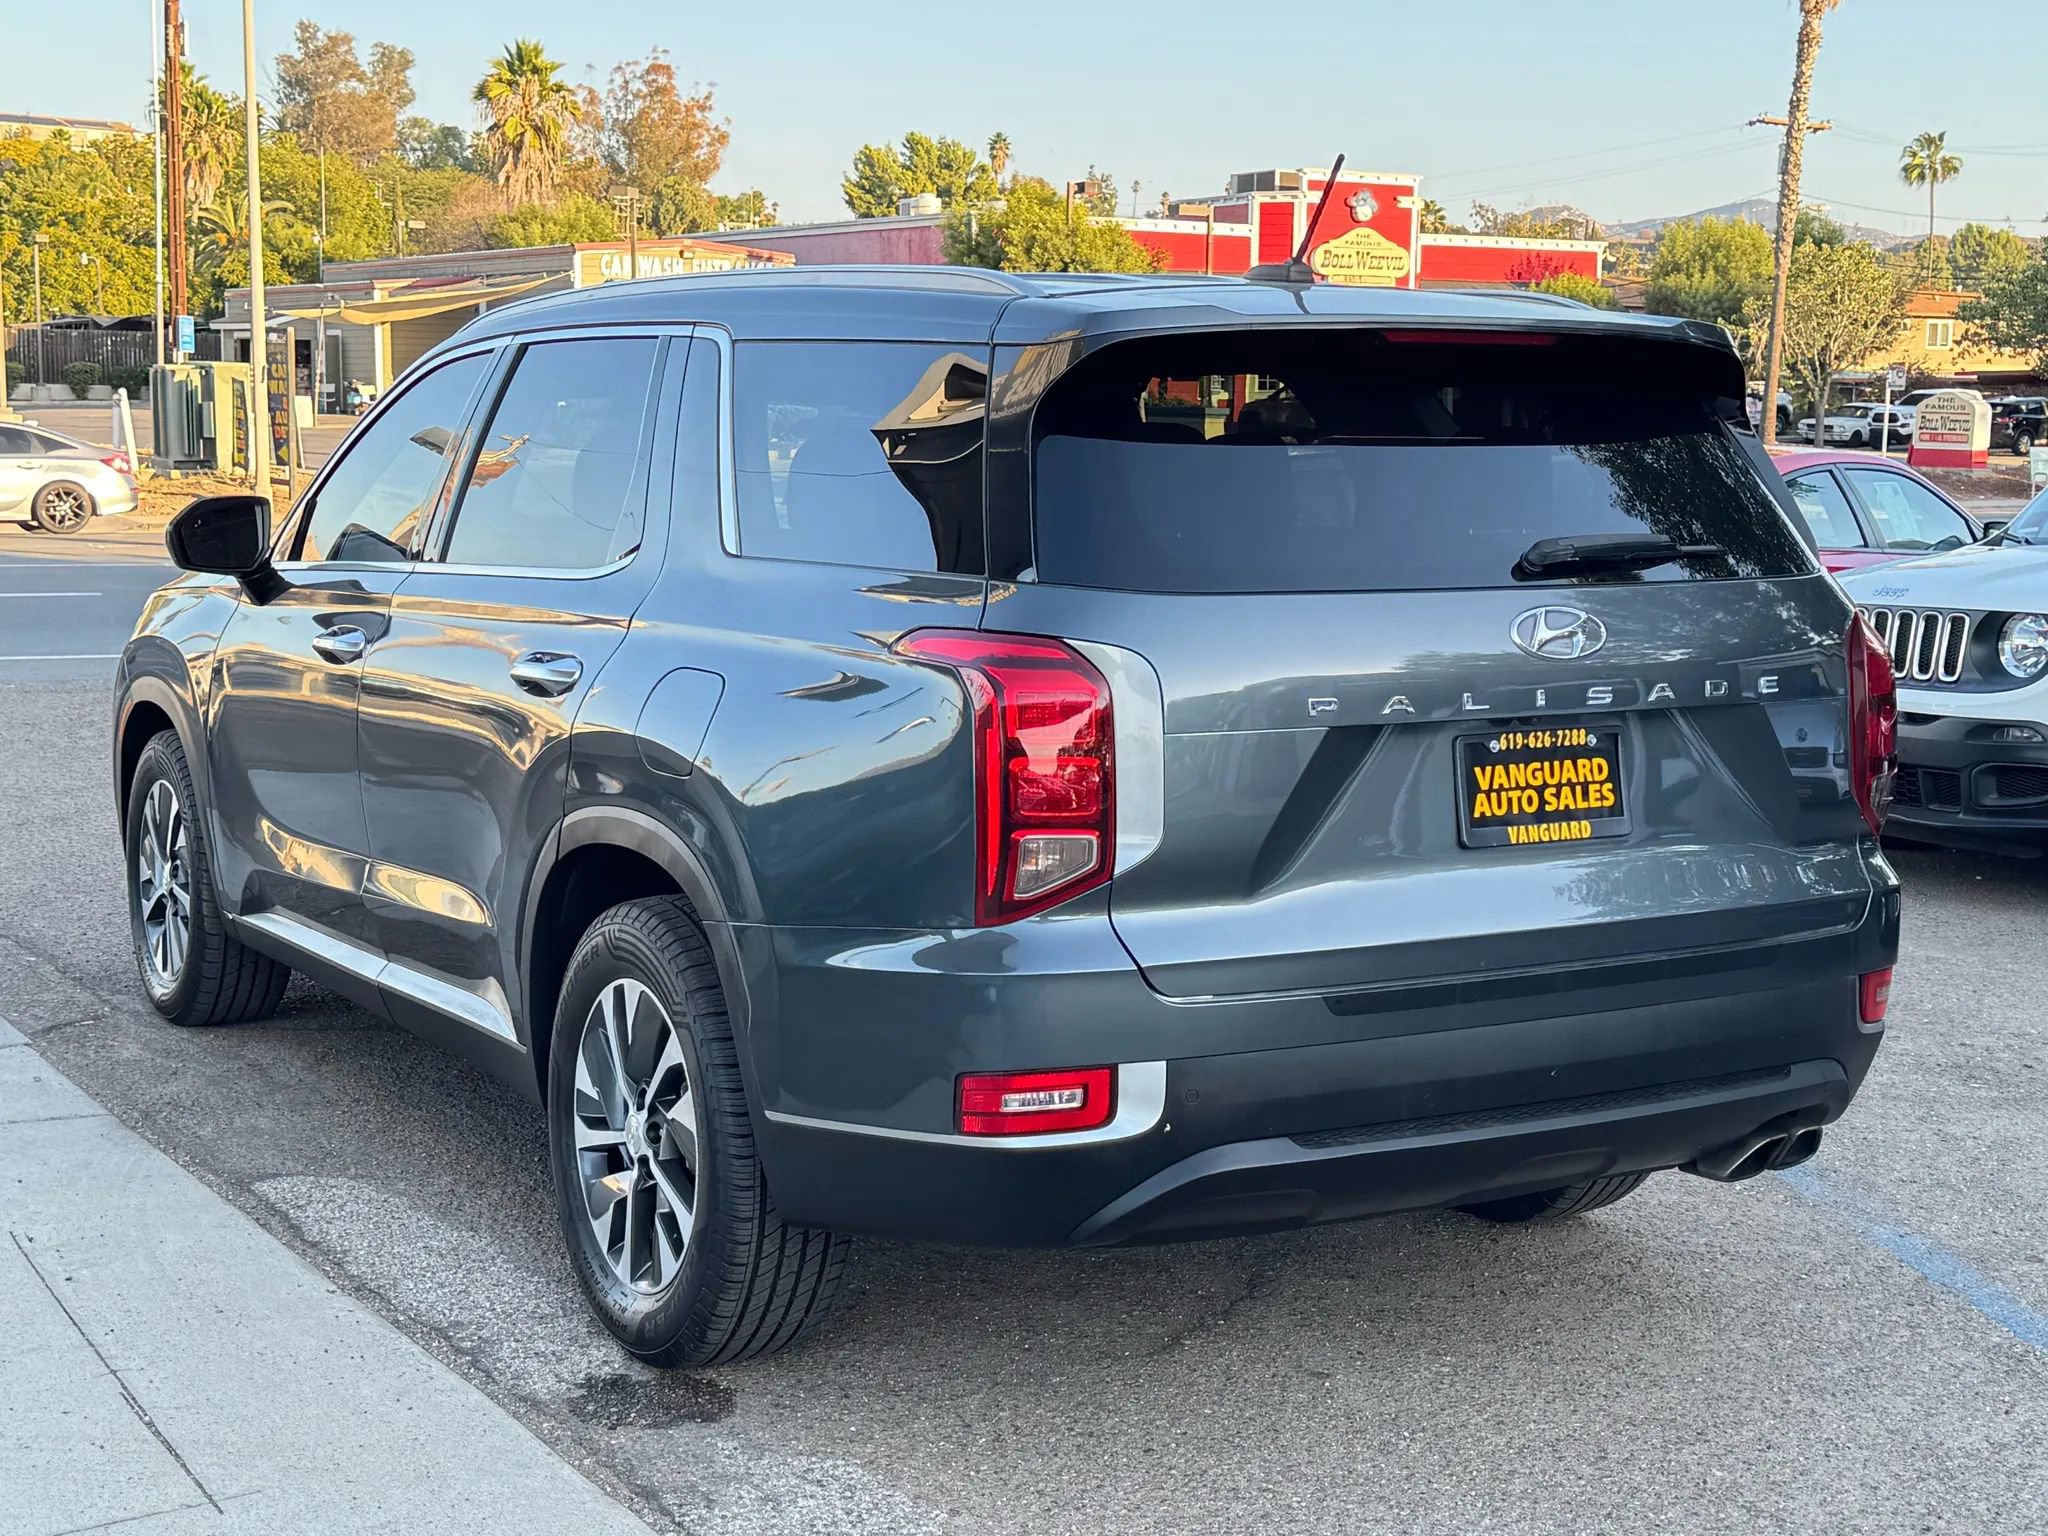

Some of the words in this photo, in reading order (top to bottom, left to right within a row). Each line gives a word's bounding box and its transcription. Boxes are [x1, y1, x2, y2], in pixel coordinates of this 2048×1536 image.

[637, 255, 684, 277] WASH
[1308, 675, 1780, 717] PALISADE
[1473, 757, 1610, 791] VANGUARD
[1473, 788, 1540, 819] AUTO
[1543, 782, 1616, 812] SALES
[1507, 820, 1593, 845] VANGUARD
